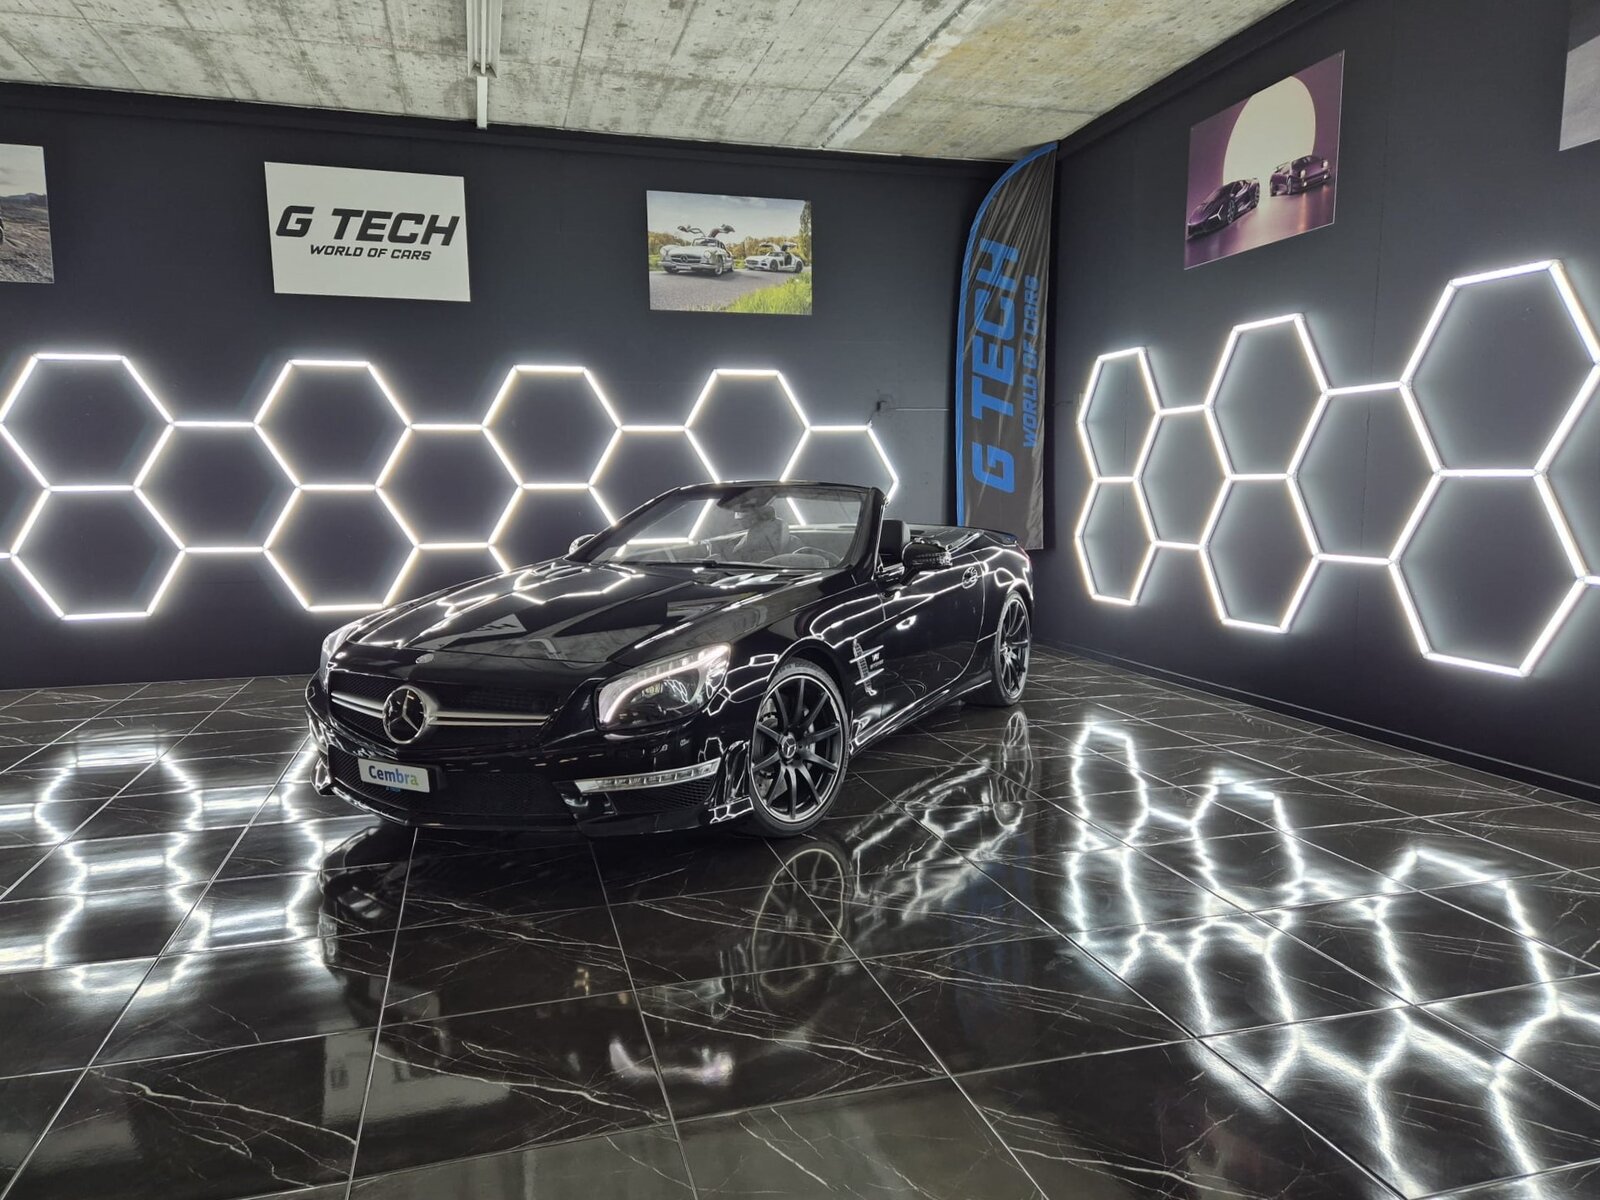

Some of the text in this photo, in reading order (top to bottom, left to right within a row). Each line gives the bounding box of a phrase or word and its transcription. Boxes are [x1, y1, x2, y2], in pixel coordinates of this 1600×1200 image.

[276, 205, 460, 246] G TECH
[310, 244, 432, 261] WORLD OF CARS
[972, 238, 1018, 493] G TECH
[1023, 339, 1037, 369] OF
[1023, 374, 1038, 448] WORLD
[368, 765, 419, 786] Cembra
